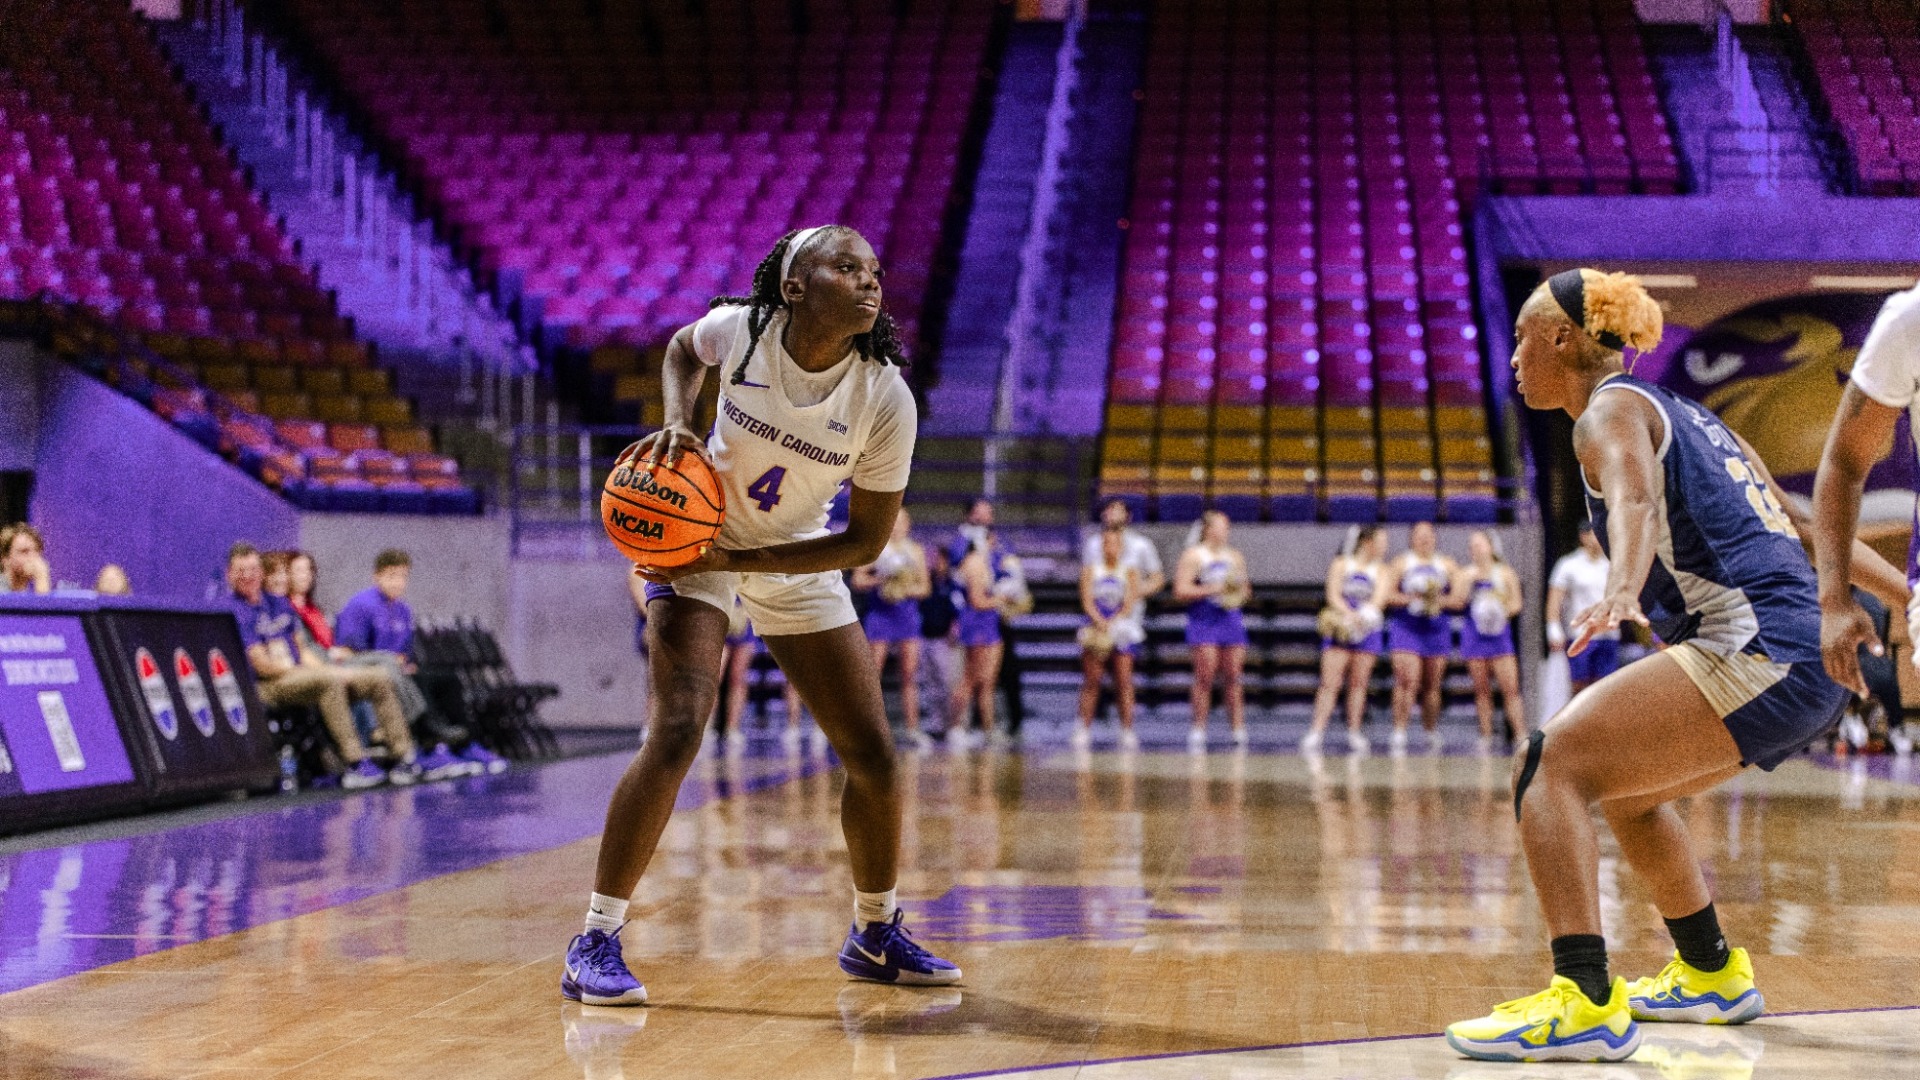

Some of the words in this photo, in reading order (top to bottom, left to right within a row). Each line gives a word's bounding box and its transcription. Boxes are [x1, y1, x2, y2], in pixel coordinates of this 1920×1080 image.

[723, 398, 781, 442] WESTERN
[781, 434, 850, 466] CAROLINA
[613, 466, 688, 511] Wilson
[747, 465, 787, 513] 4
[610, 507, 664, 540] NCAA
